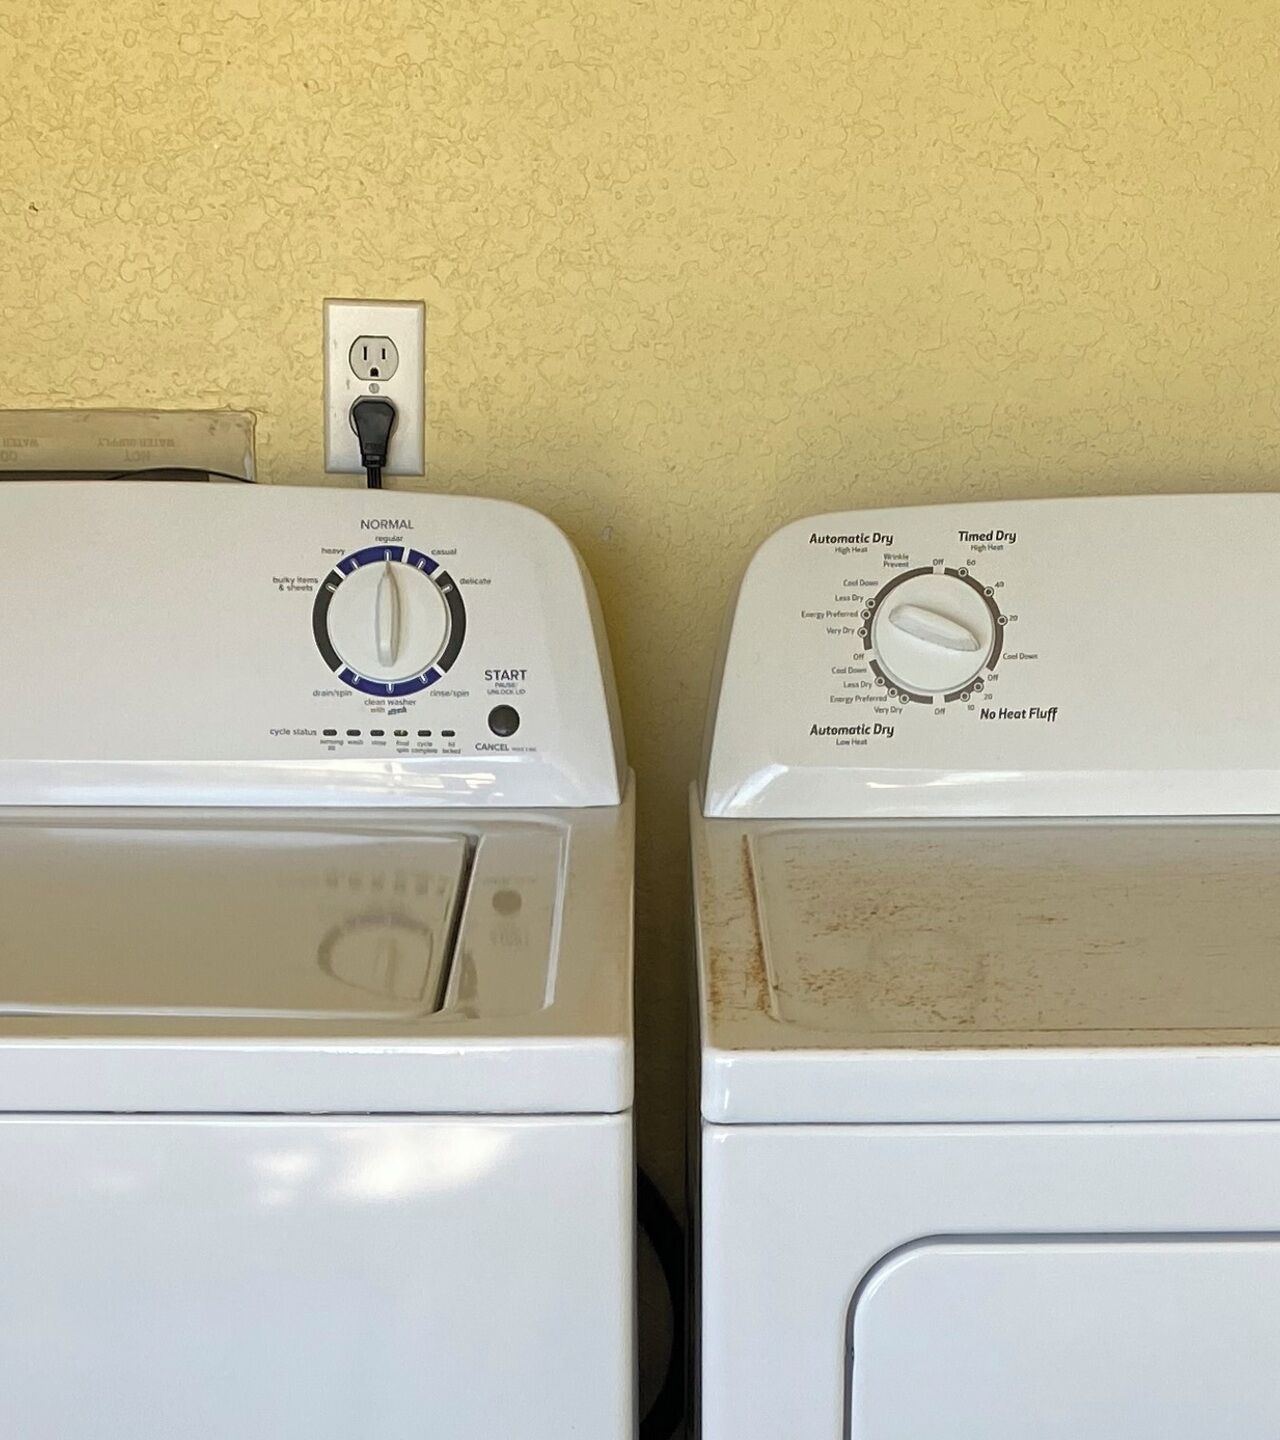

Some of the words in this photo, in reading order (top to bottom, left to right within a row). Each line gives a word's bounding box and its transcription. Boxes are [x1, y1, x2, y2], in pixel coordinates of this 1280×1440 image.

[361, 519, 413, 529] NORMAL
[375, 535, 403, 543] regular
[810, 533, 870, 543] Automatic
[873, 533, 893, 546] Dry
[958, 530, 993, 541] Timed
[996, 530, 1016, 544] Dry
[321, 548, 345, 556] heavy
[273, 577, 295, 585] bulky
[297, 576, 318, 584] items
[459, 577, 491, 585] delicate
[287, 583, 313, 591] sheets
[485, 670, 527, 681] START
[313, 689, 352, 698] drain/spin
[430, 690, 469, 698] rinse/spin
[364, 698, 385, 706] clean
[387, 698, 416, 706] washer
[980, 708, 996, 719] No
[999, 708, 1026, 719] Heat
[1029, 707, 1058, 722] Fluff
[270, 728, 290, 736] cycle
[810, 724, 870, 735] Automatic
[873, 723, 894, 738] Dry
[475, 743, 509, 751] CANCEL
